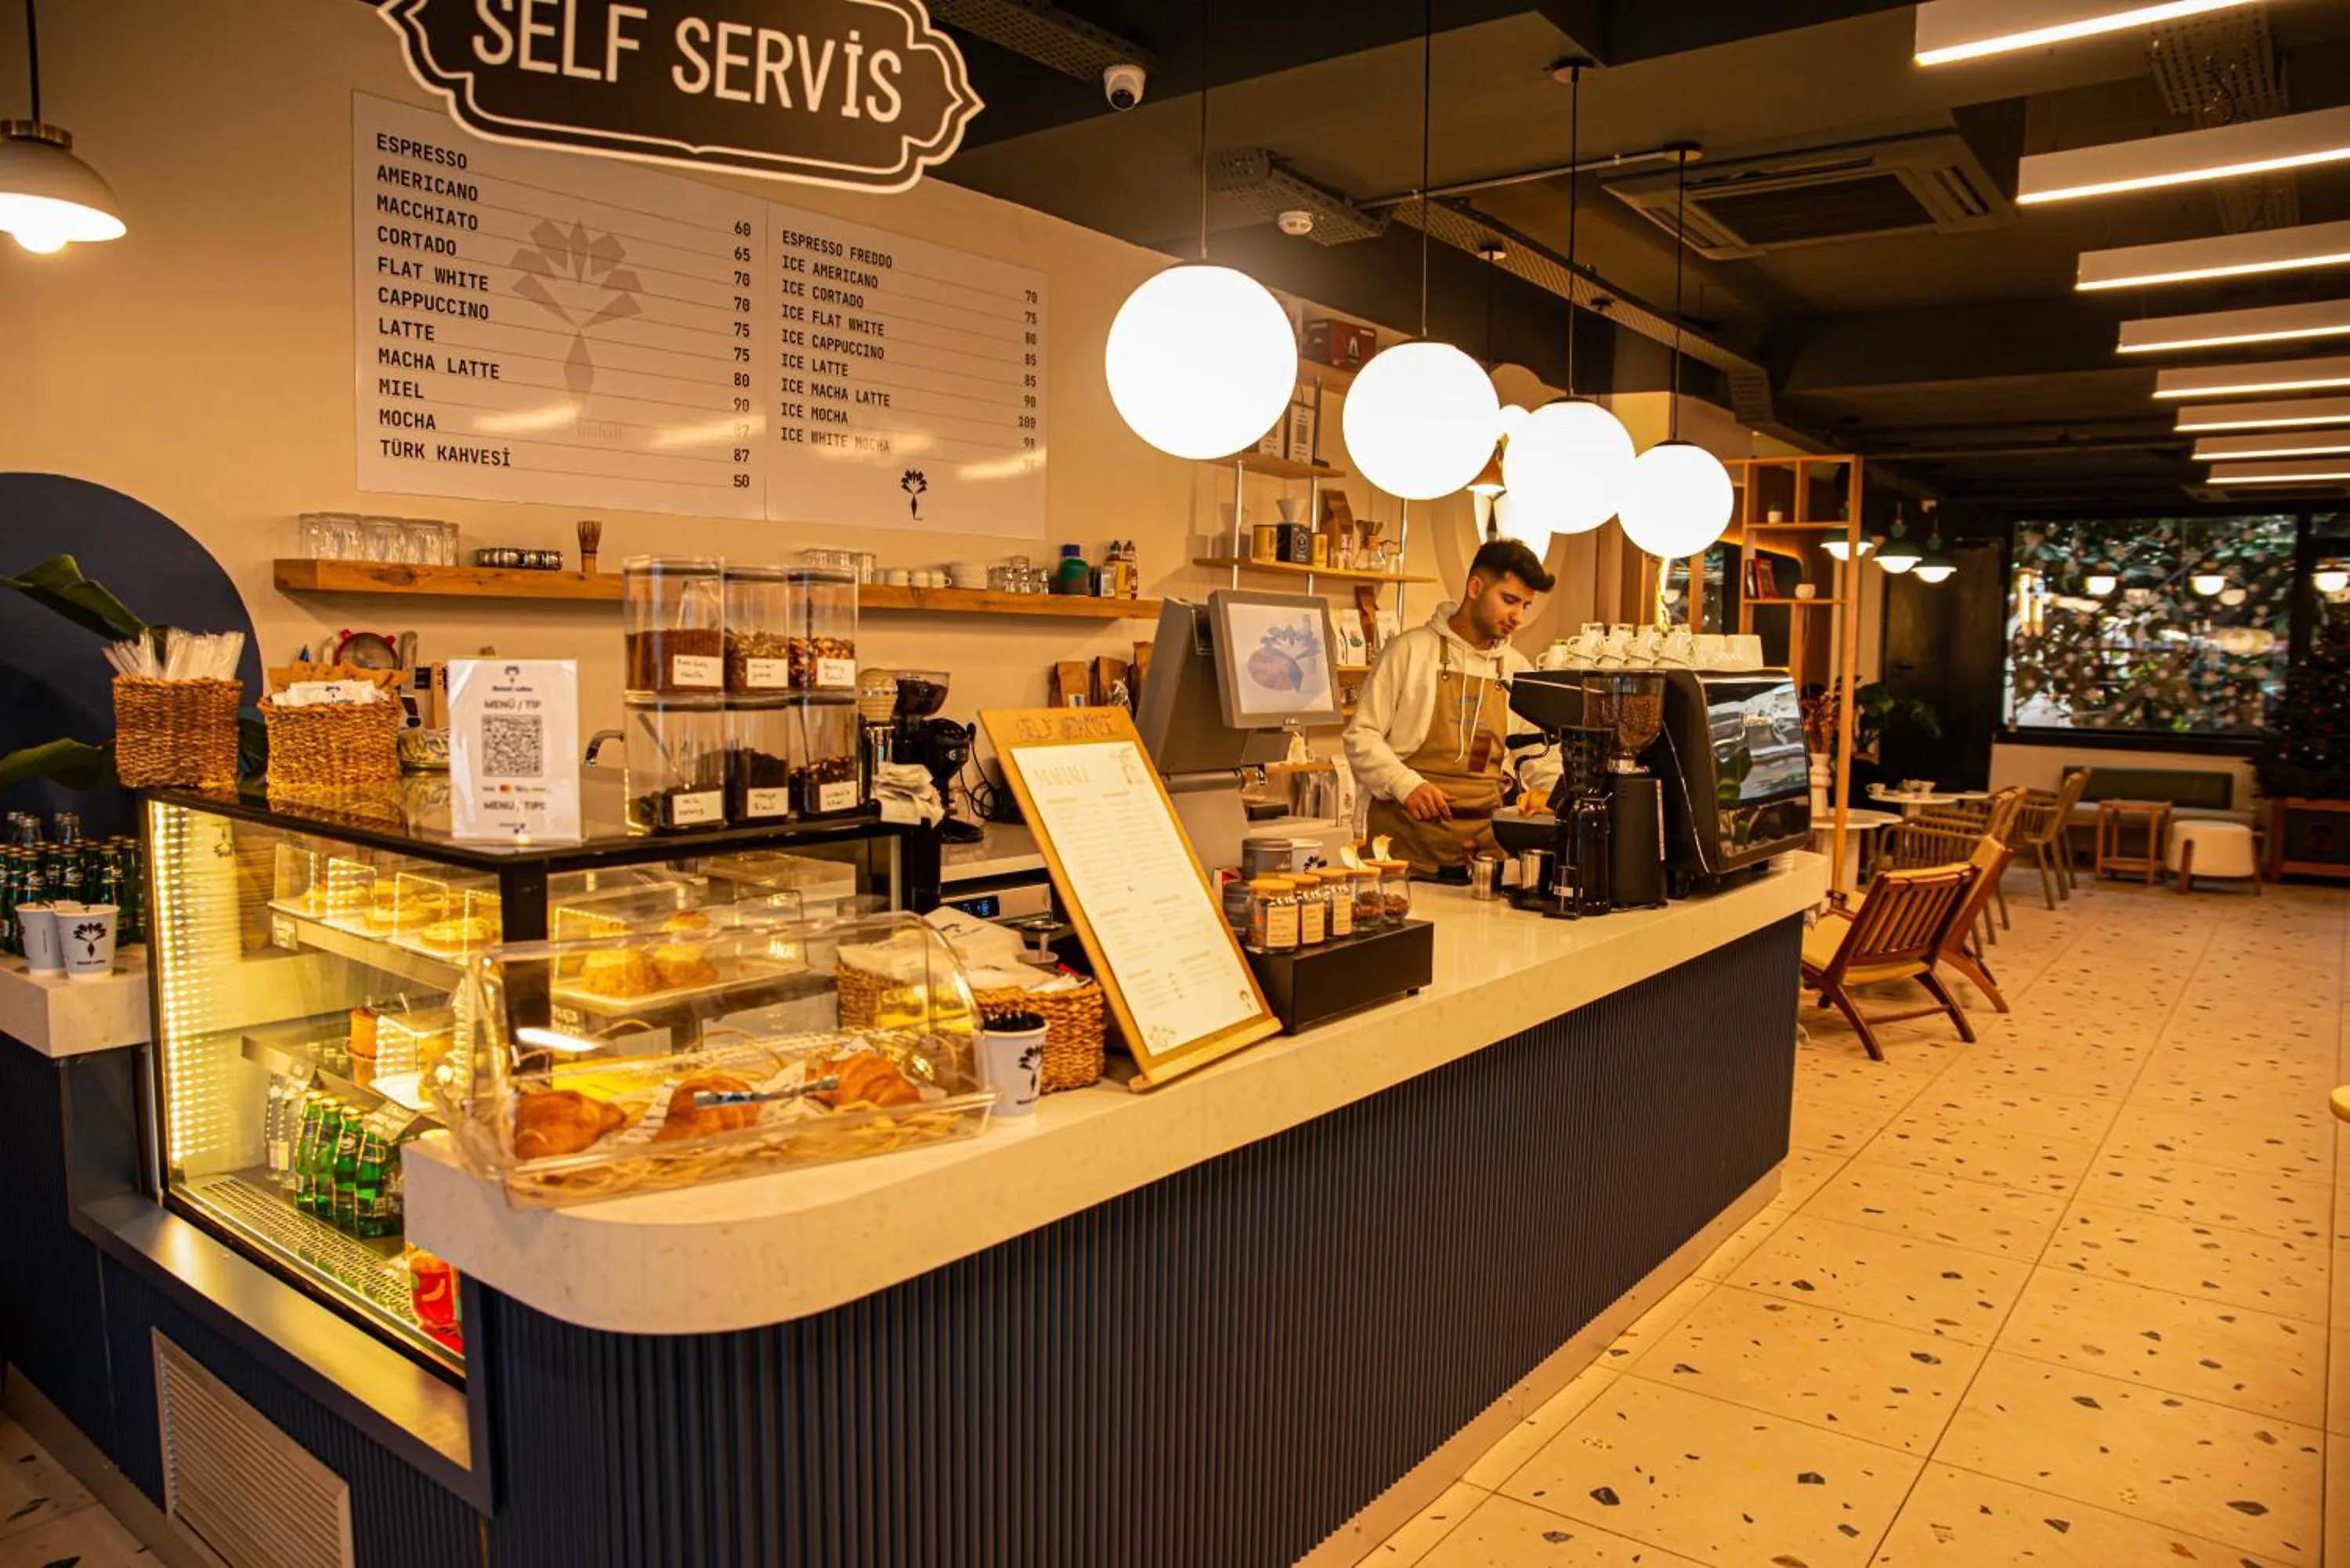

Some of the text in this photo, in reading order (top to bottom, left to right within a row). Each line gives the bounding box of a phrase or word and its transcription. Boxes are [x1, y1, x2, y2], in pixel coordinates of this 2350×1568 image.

[472, 0, 902, 123] SELF SERVİS
[377, 133, 751, 237] ESPRESSO 60
[377, 164, 751, 262] AMERICANO 65
[377, 194, 750, 287] MACCHIATO 70
[378, 225, 750, 313] CORTADO 70
[783, 229, 1038, 304] ESPRESSO FREDDO 70
[378, 256, 750, 338] FLAT WHITE 75
[782, 279, 804, 297] ICE
[812, 286, 864, 309] CORTADO
[782, 304, 804, 321] ICE
[812, 309, 842, 327] FLAT
[848, 317, 884, 337] WHITE
[783, 255, 1037, 325] ICE AMERICANO 75
[378, 287, 750, 363] CAPPUCCINO 75
[378, 317, 750, 388] LATTE 80
[782, 328, 804, 345] ICE
[812, 334, 884, 360] CAPPUCCINO
[378, 347, 750, 412] MACHA LATTE 90
[378, 378, 424, 399] MIEL
[781, 378, 1036, 429] ICE MACHA LATTE 100
[782, 353, 1036, 408] ICE LATTE 90
[379, 408, 750, 463] MOCHA 87
[781, 402, 803, 418] ICE
[811, 406, 848, 424] MOCHA
[781, 426, 803, 443] ICE
[810, 429, 848, 446] WHITE
[854, 435, 891, 453] MOCHA
[380, 438, 750, 488] TÜRK KAHVESİ 50
